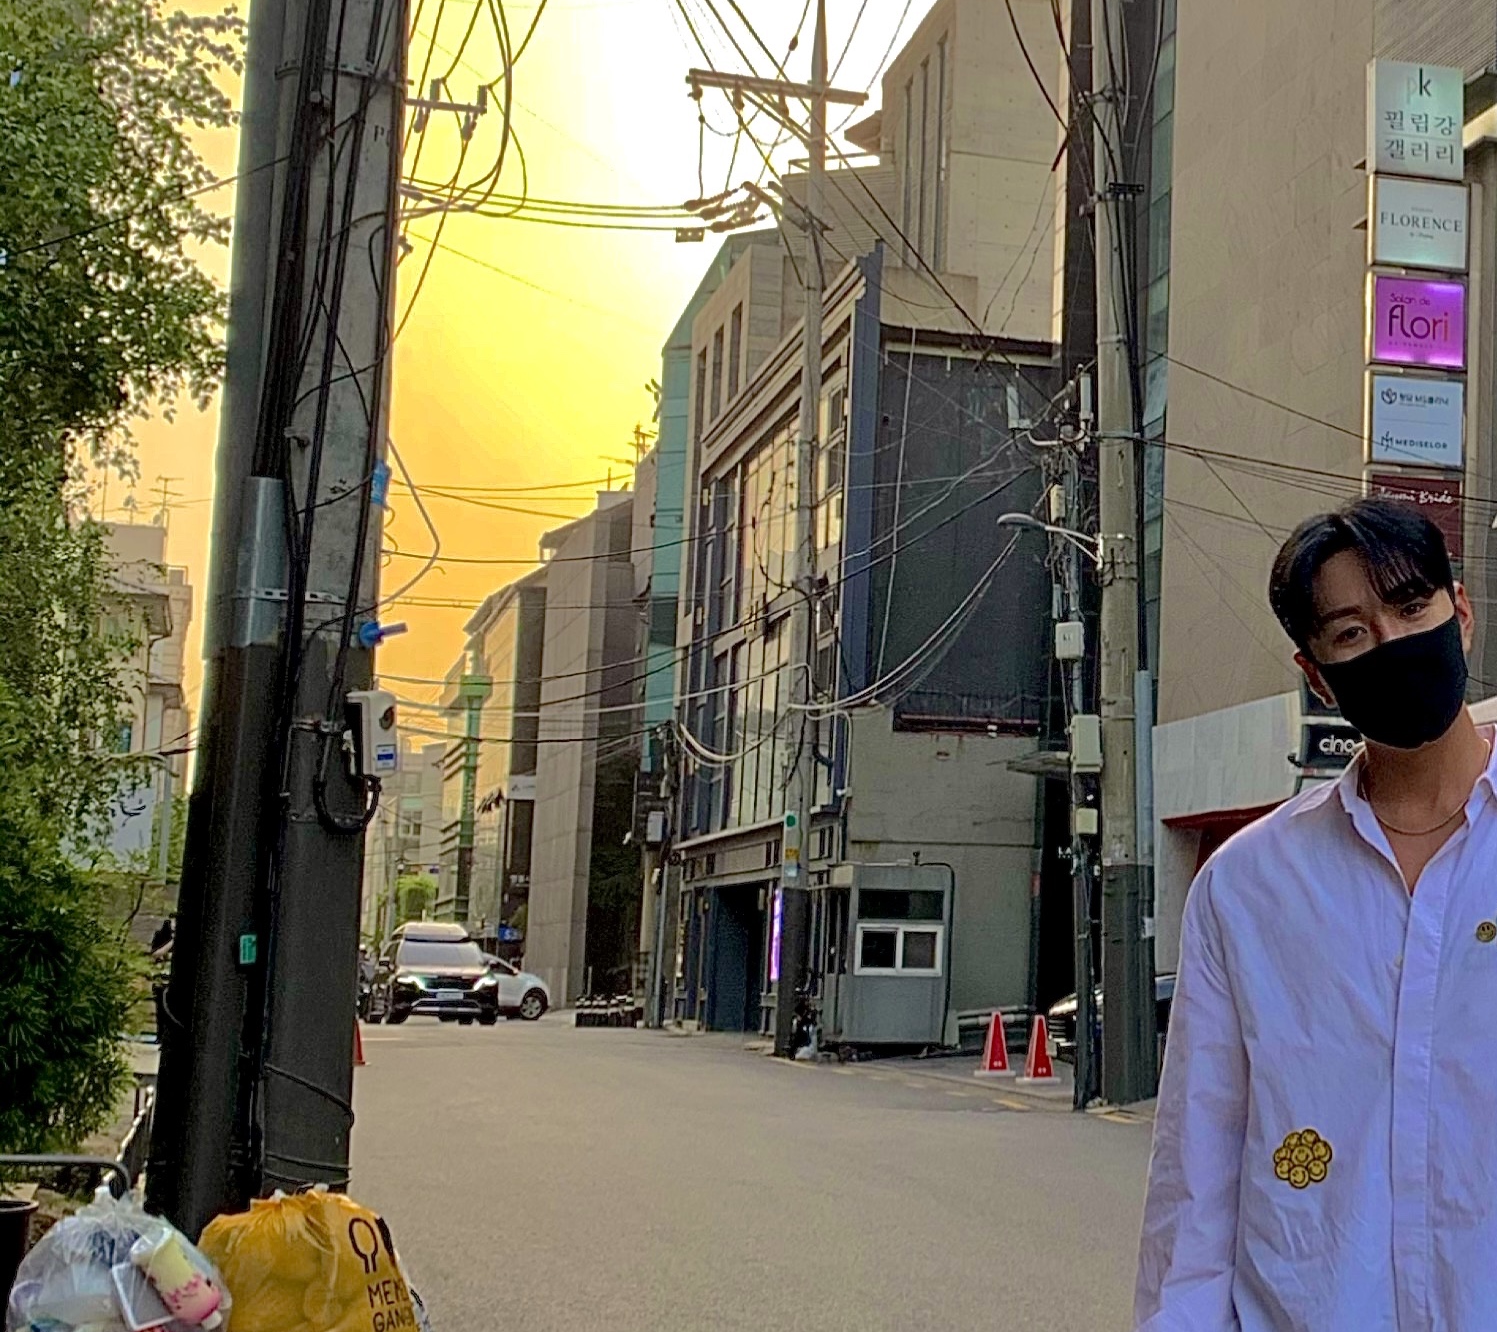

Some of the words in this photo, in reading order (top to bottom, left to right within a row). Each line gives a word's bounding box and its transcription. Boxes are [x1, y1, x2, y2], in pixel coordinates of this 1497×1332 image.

[1384, 110, 1457, 136] 필립강
[1384, 139, 1454, 165] 갤러리
[1380, 211, 1463, 233] FLORENCE
[1388, 303, 1449, 343] flori
